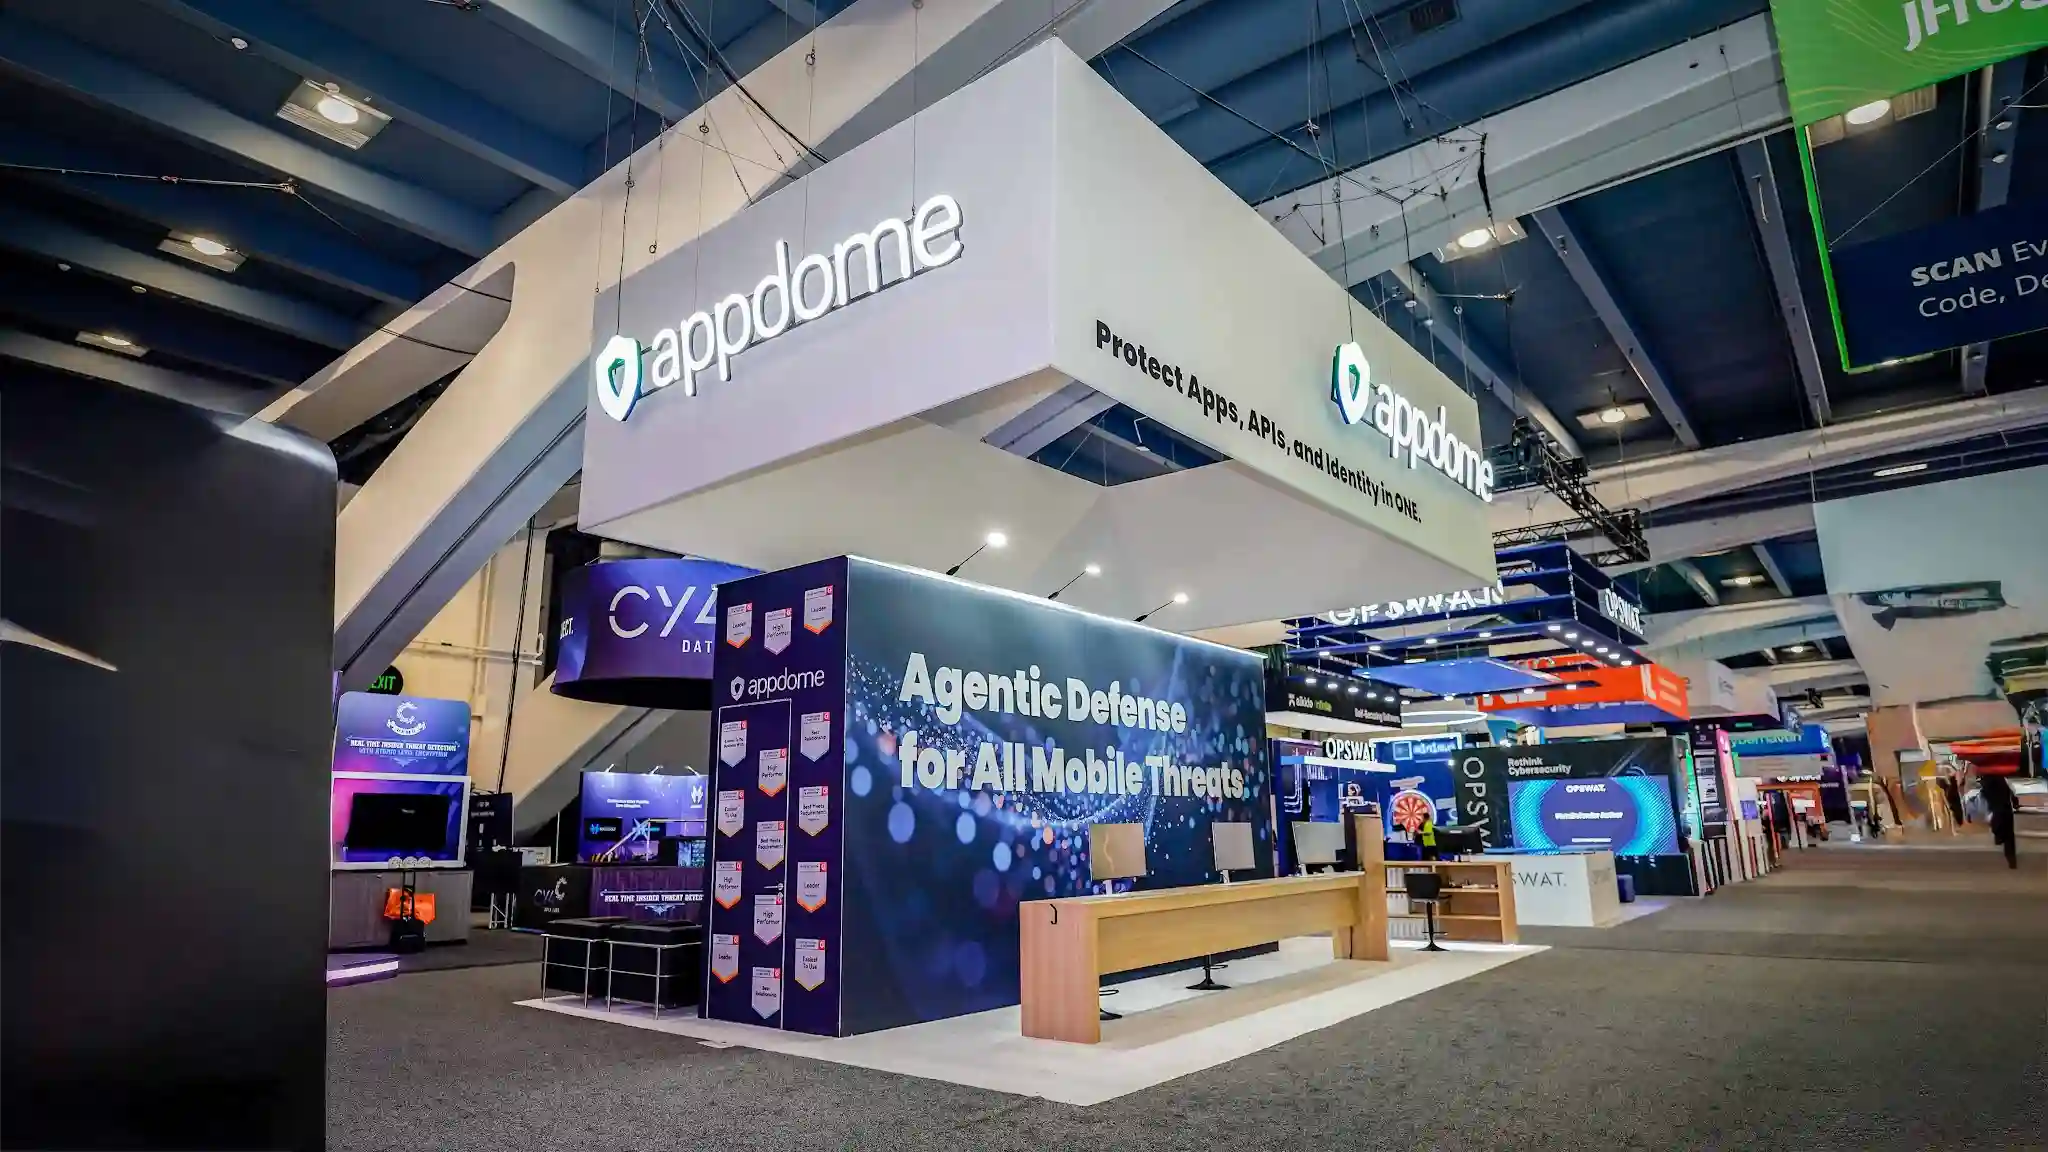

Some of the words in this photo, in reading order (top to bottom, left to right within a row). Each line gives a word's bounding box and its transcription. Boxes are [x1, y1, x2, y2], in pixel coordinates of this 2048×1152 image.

[1911, 247, 2002, 287] SCAN
[651, 194, 964, 397] appdome
[1919, 286, 2005, 317] Code,
[1096, 319, 1183, 394] Protect
[1188, 374, 1244, 431] Apps,
[1248, 409, 1291, 455] APIs,
[1294, 439, 1323, 470] and
[1326, 452, 1379, 507] Identity
[1381, 481, 1394, 507] in
[1395, 494, 1422, 523] ONE.
[1373, 383, 1494, 502] appdome
[732, 621, 747, 629] Leader
[766, 631, 789, 639] Performer
[772, 624, 784, 632] High
[748, 667, 825, 700] appdome
[899, 652, 1062, 725] Agentic
[1066, 677, 1188, 733] Defense
[350, 739, 365, 747] REAL
[381, 741, 404, 749] INSIDER
[427, 744, 457, 752] DETECTION
[899, 731, 966, 789] for
[971, 741, 1025, 792] All
[1032, 746, 1143, 795] Mobile
[1146, 755, 1245, 800] Threats
[1508, 757, 1543, 766] Rethink
[1508, 764, 1572, 776] Cybersecurity
[604, 895, 620, 903] REAL
[620, 895, 636, 903] TIME
[636, 894, 660, 902] INSIDER
[661, 894, 684, 902] THREAT
[763, 911, 774, 919] High
